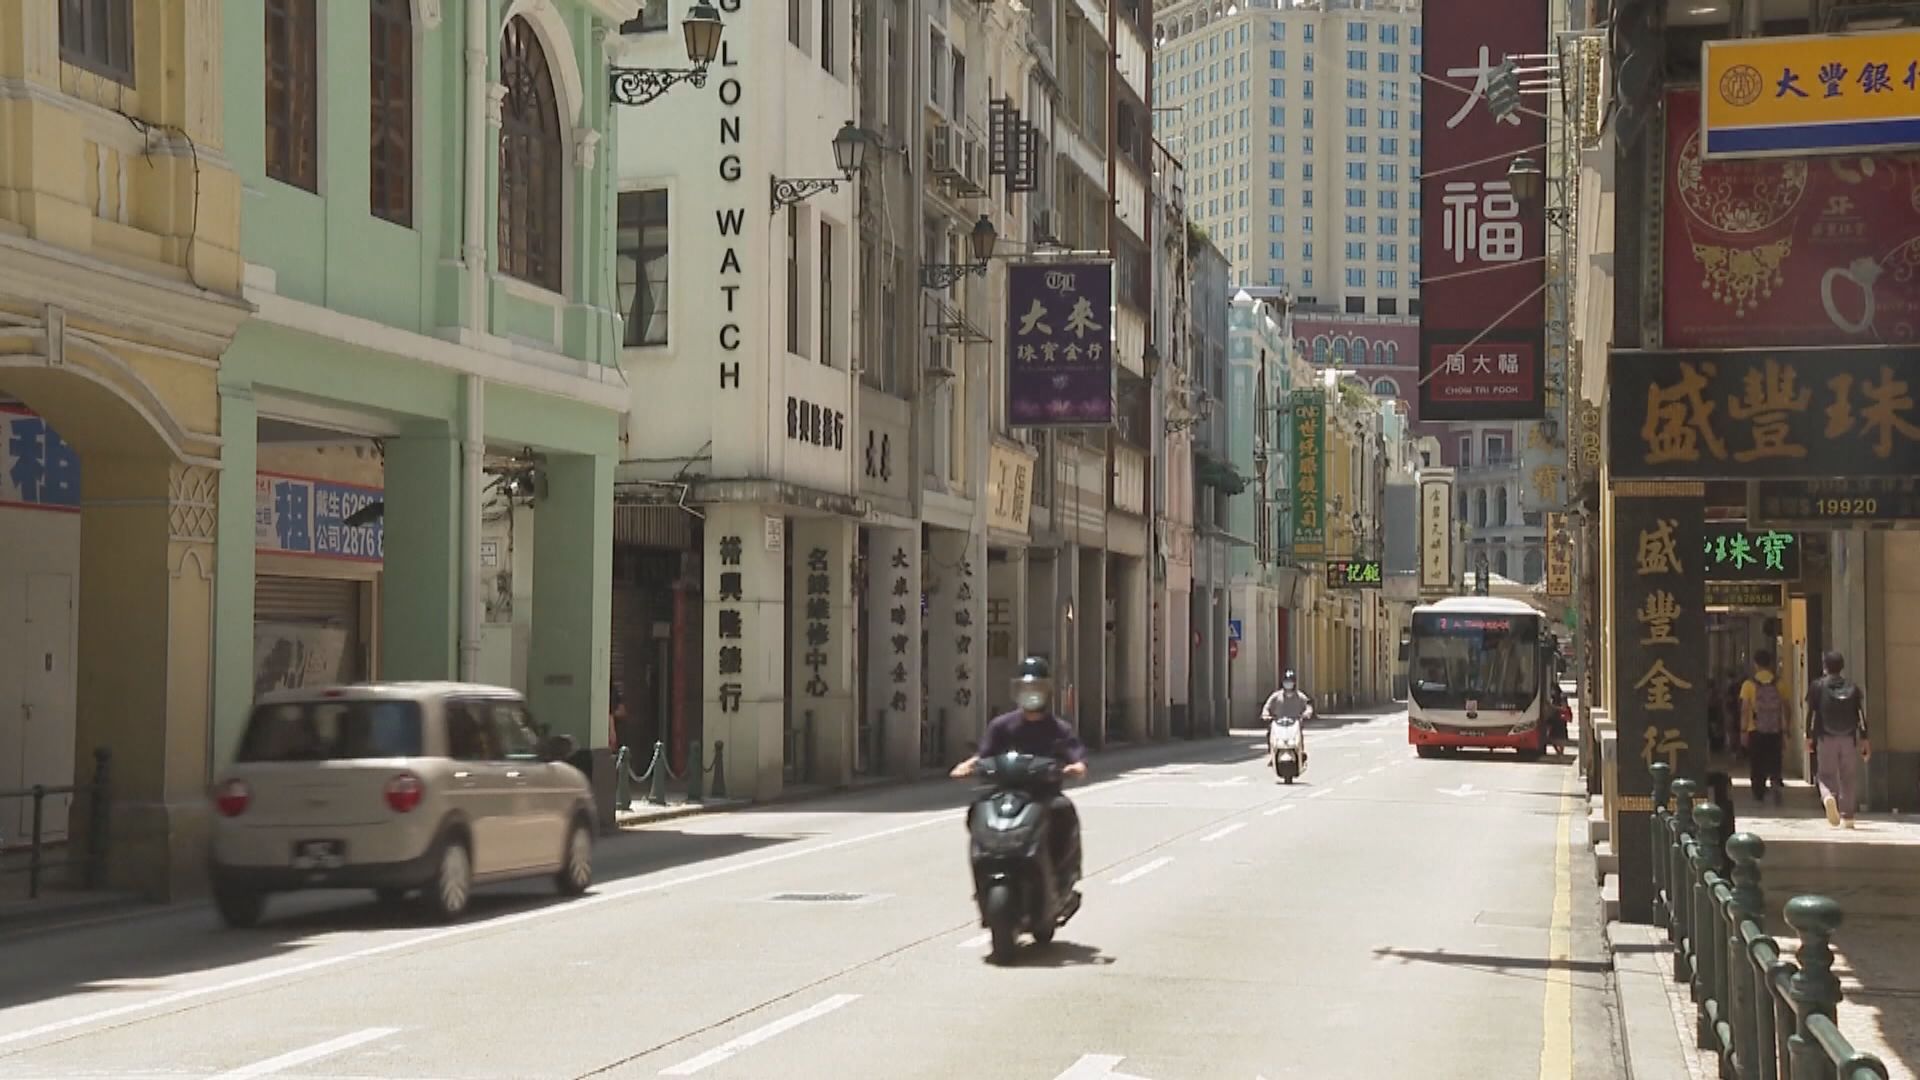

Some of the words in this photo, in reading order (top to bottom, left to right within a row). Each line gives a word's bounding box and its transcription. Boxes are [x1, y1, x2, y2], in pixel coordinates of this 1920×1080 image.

[719, 40, 741, 182] LONG
[716, 208, 744, 389] WATCH
[1017, 342, 1103, 362] 珠寶金行
[1446, 354, 1519, 375] 周大福
[1445, 386, 1472, 395] CHOW
[1475, 386, 1490, 394] TAI
[1493, 386, 1518, 394] FOOK
[1641, 360, 1920, 464] 盛豐珠
[9, 418, 81, 505] 租
[275, 481, 310, 550] 租
[316, 525, 340, 551] 公司
[342, 526, 375, 556] 2876
[1817, 500, 1877, 514] 19920
[1634, 518, 1692, 775] 盛豐金行
